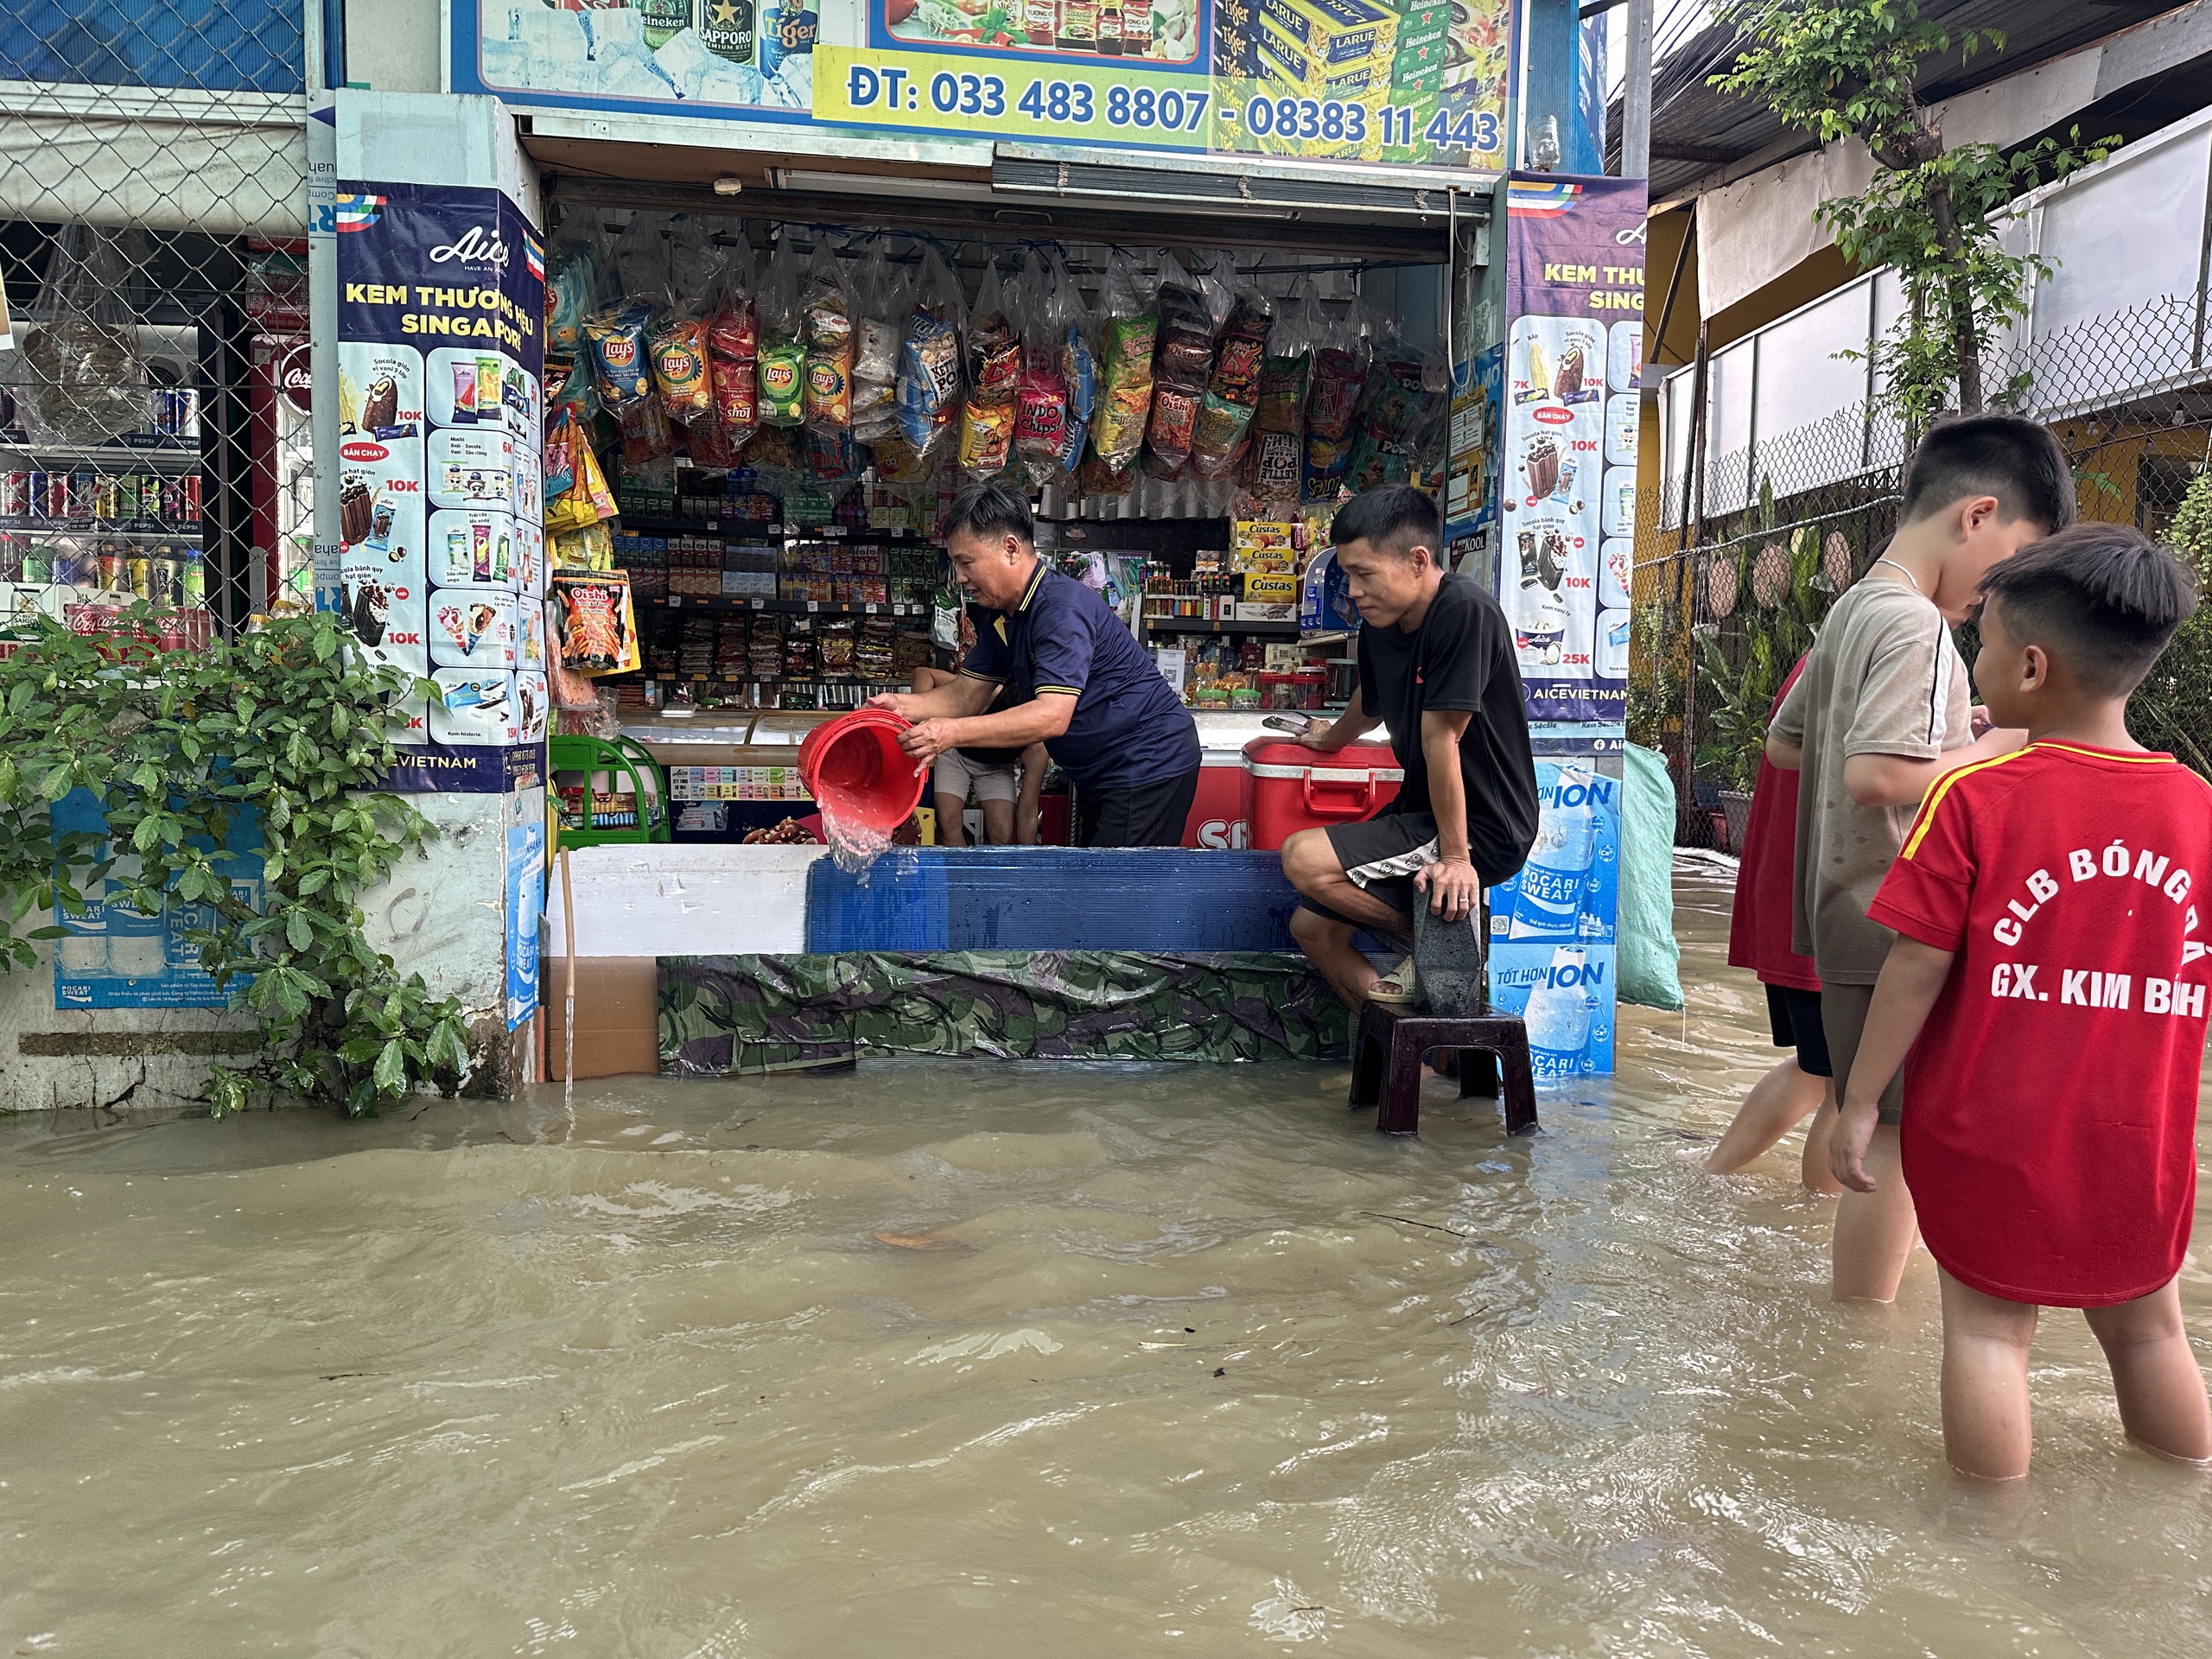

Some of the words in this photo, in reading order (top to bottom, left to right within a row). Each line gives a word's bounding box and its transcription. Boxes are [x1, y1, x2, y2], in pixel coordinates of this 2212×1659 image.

[699, 26, 752, 46] SAPPORO
[764, 16, 817, 49] Tiger
[1221, 25, 1247, 57] Tiger
[1335, 30, 1376, 48] LARUE
[1405, 29, 1443, 48] Heineken
[1262, 29, 1302, 69] LARUE
[1220, 54, 1247, 85] Tiger
[1402, 61, 1440, 84] Heineken
[1332, 71, 1371, 90] LARUE
[849, 67, 918, 110] ĐT:
[930, 73, 1007, 116] 033
[1017, 80, 1095, 123] 483
[1106, 88, 1210, 131] 8807
[1247, 97, 1366, 142] 08383
[1377, 106, 1412, 146] 11
[1425, 110, 1498, 151] 443
[429, 226, 510, 268] Aice
[1543, 264, 1597, 283] KEM
[346, 283, 408, 305] KEM
[415, 285, 513, 320] THƯƠNG
[401, 314, 522, 353] SINGAPORE
[605, 341, 635, 359] Lay's
[1170, 345, 1198, 359] Oishi
[664, 354, 690, 372] Lay's
[811, 372, 836, 387] Lay's
[1513, 380, 1529, 389] 7K
[1584, 378, 1604, 387] 10K
[1022, 401, 1059, 419] INDO
[1161, 394, 1191, 411] Oishi
[397, 410, 423, 421] 10K
[360, 449, 385, 459] CHẠY
[502, 441, 512, 454] 6K
[1571, 440, 1598, 451] 10K
[1262, 456, 1298, 470] POP
[1260, 467, 1297, 480] KETTLE
[385, 480, 419, 493] 10K
[1249, 524, 1281, 533] Custas
[1465, 535, 1485, 553] KOOL
[1252, 550, 1283, 559] Custas
[372, 566, 385, 575] quy
[1251, 579, 1293, 592] Custas
[1565, 577, 1591, 588] 10K
[571, 587, 608, 600] Oishi
[388, 632, 421, 645] 10K
[1528, 634, 1552, 643] Aice
[1562, 654, 1590, 664] 25K
[1553, 781, 1613, 810] ION
[1523, 867, 1580, 890] POCARI
[1521, 879, 1573, 900] SWEAT
[1993, 868, 2060, 947] CLB
[2068, 838, 2192, 905] BÓNG
[1497, 966, 1520, 985] TỐT
[1521, 967, 1548, 982] HƠN
[1547, 962, 1605, 990] ION
[1990, 962, 2049, 1002] GX.
[2061, 968, 2132, 1010] KIM
